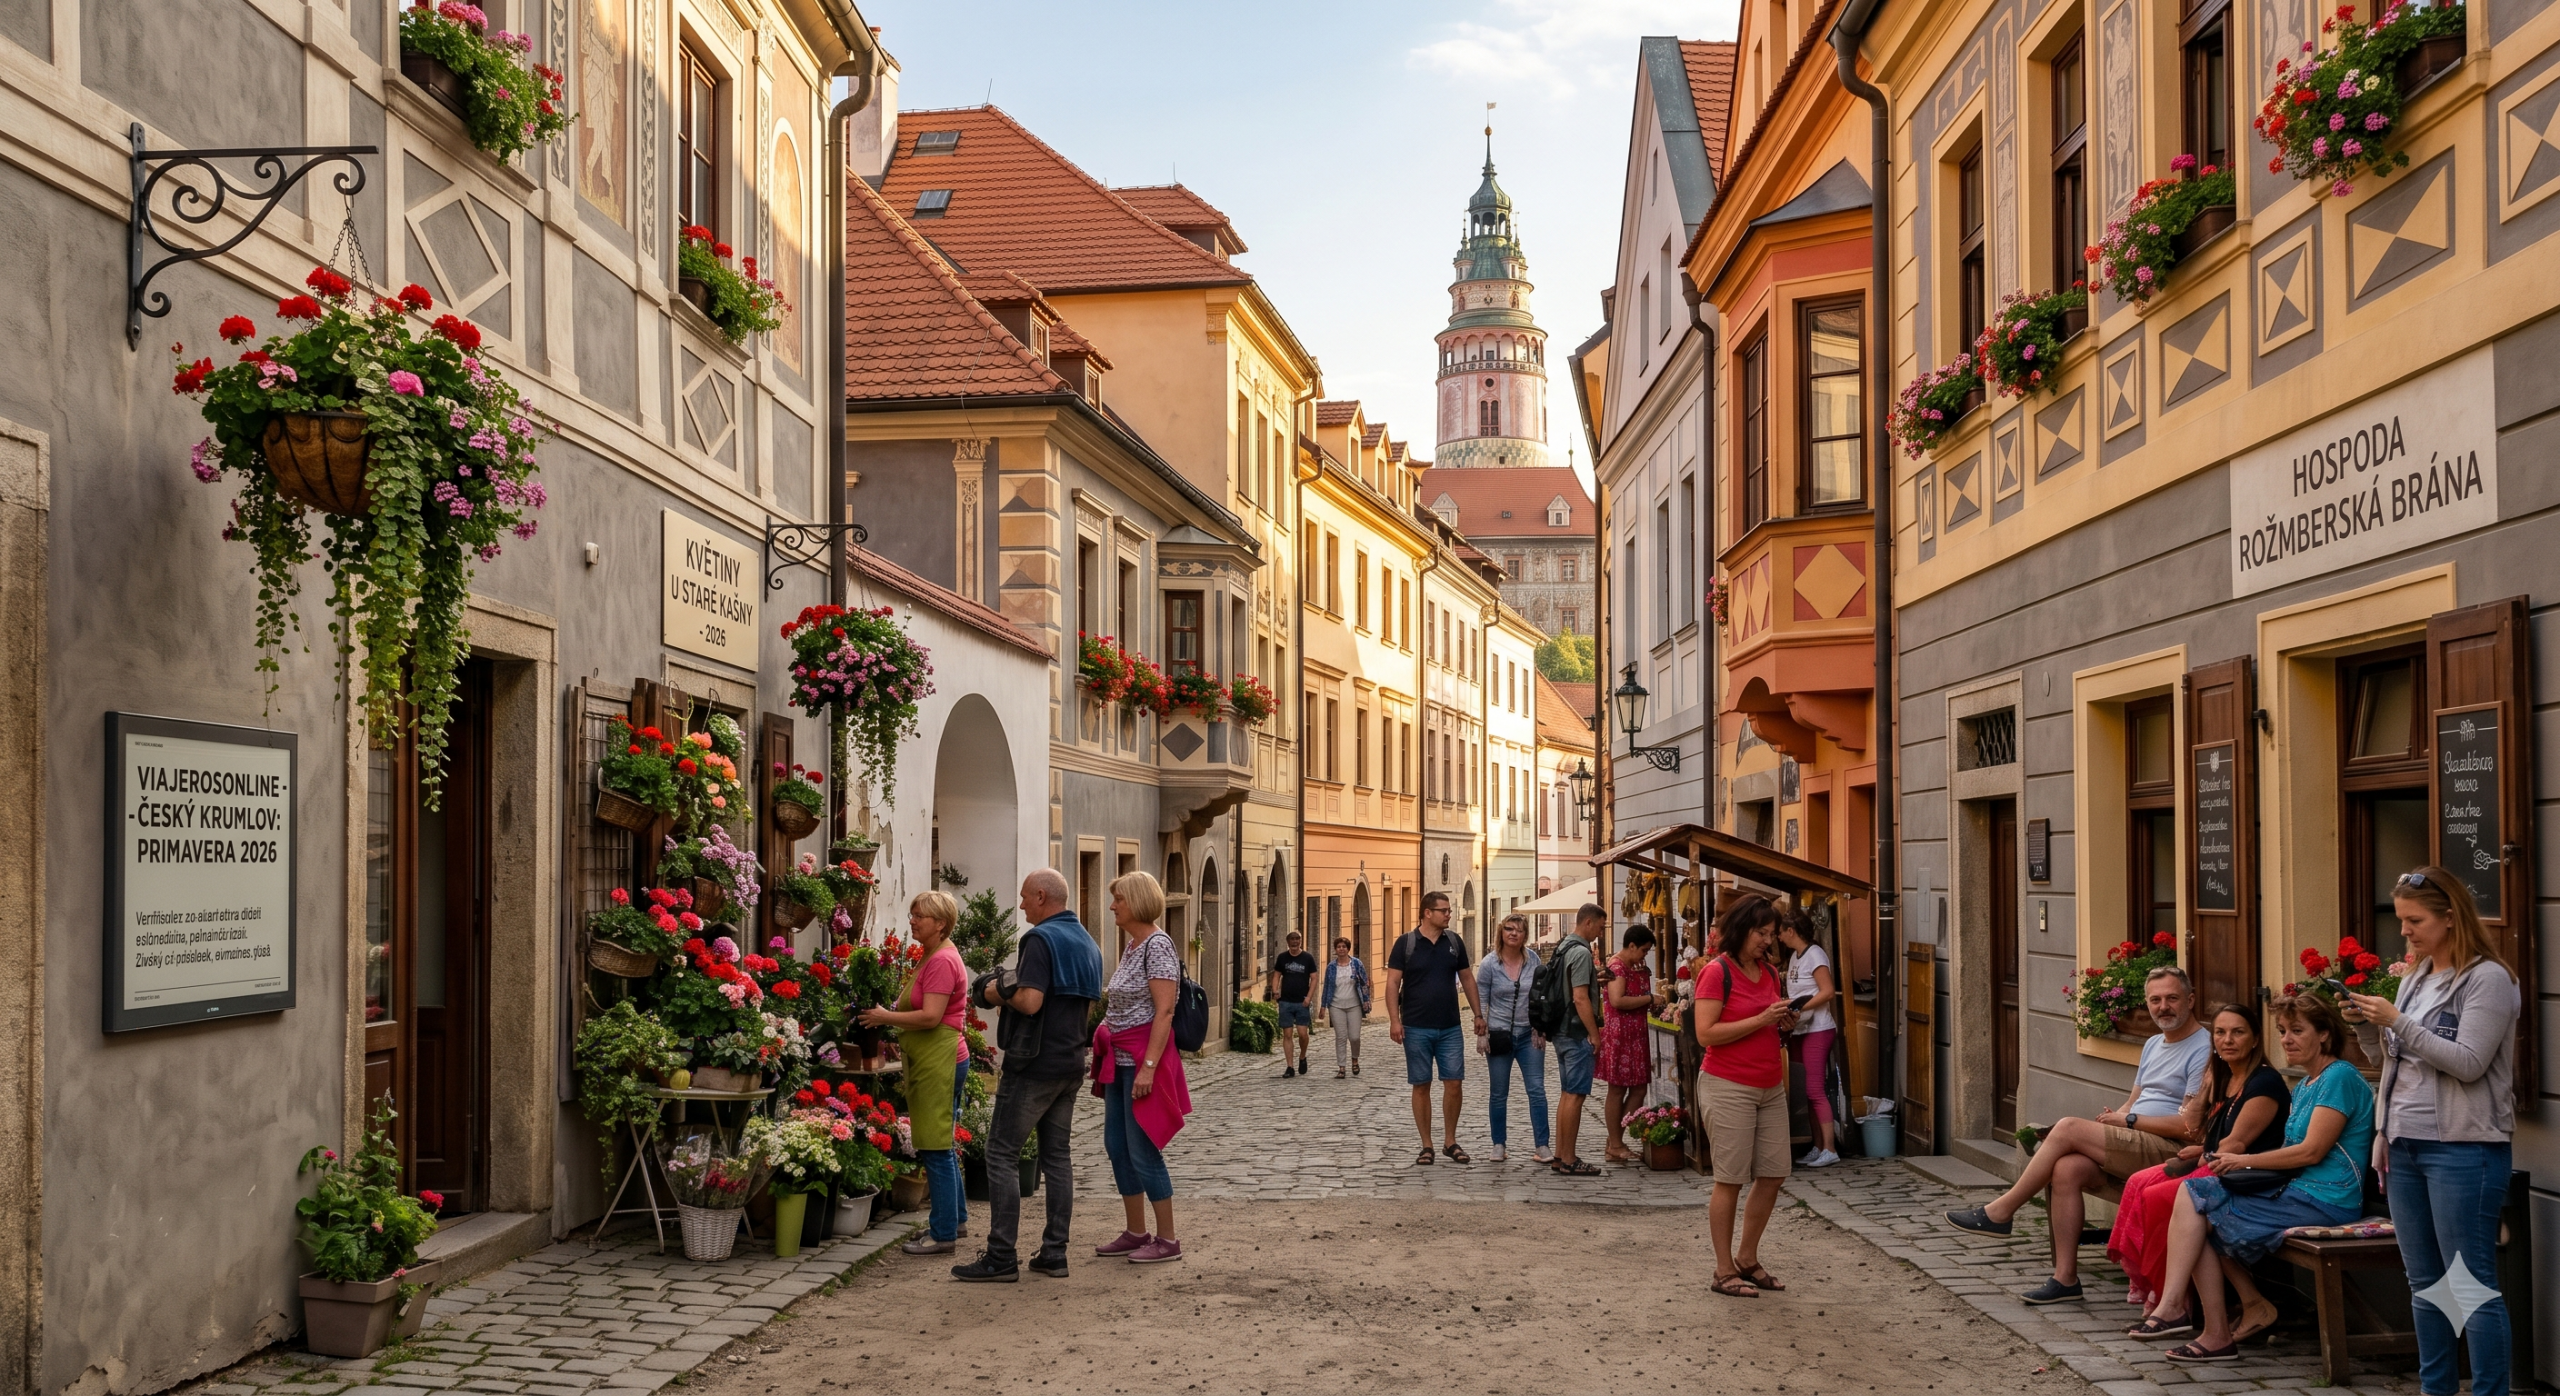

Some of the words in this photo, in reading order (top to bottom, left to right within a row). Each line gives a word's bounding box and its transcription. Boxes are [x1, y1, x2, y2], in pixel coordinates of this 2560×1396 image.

[2293, 415, 2406, 498] HOSPODA
[2239, 473, 2384, 572] ROŽMBERSKÁ
[2391, 449, 2484, 523] BRÁNA
[686, 538, 740, 588] KVĚTINY
[671, 574, 679, 599] U
[682, 579, 717, 615] STARÉ
[719, 592, 753, 627] KAŠNY
[705, 624, 726, 647] 2026
[200, 804, 281, 831] KRUMLOV:
[137, 838, 236, 864] PRIMAVERA
[240, 840, 278, 864] 2026
